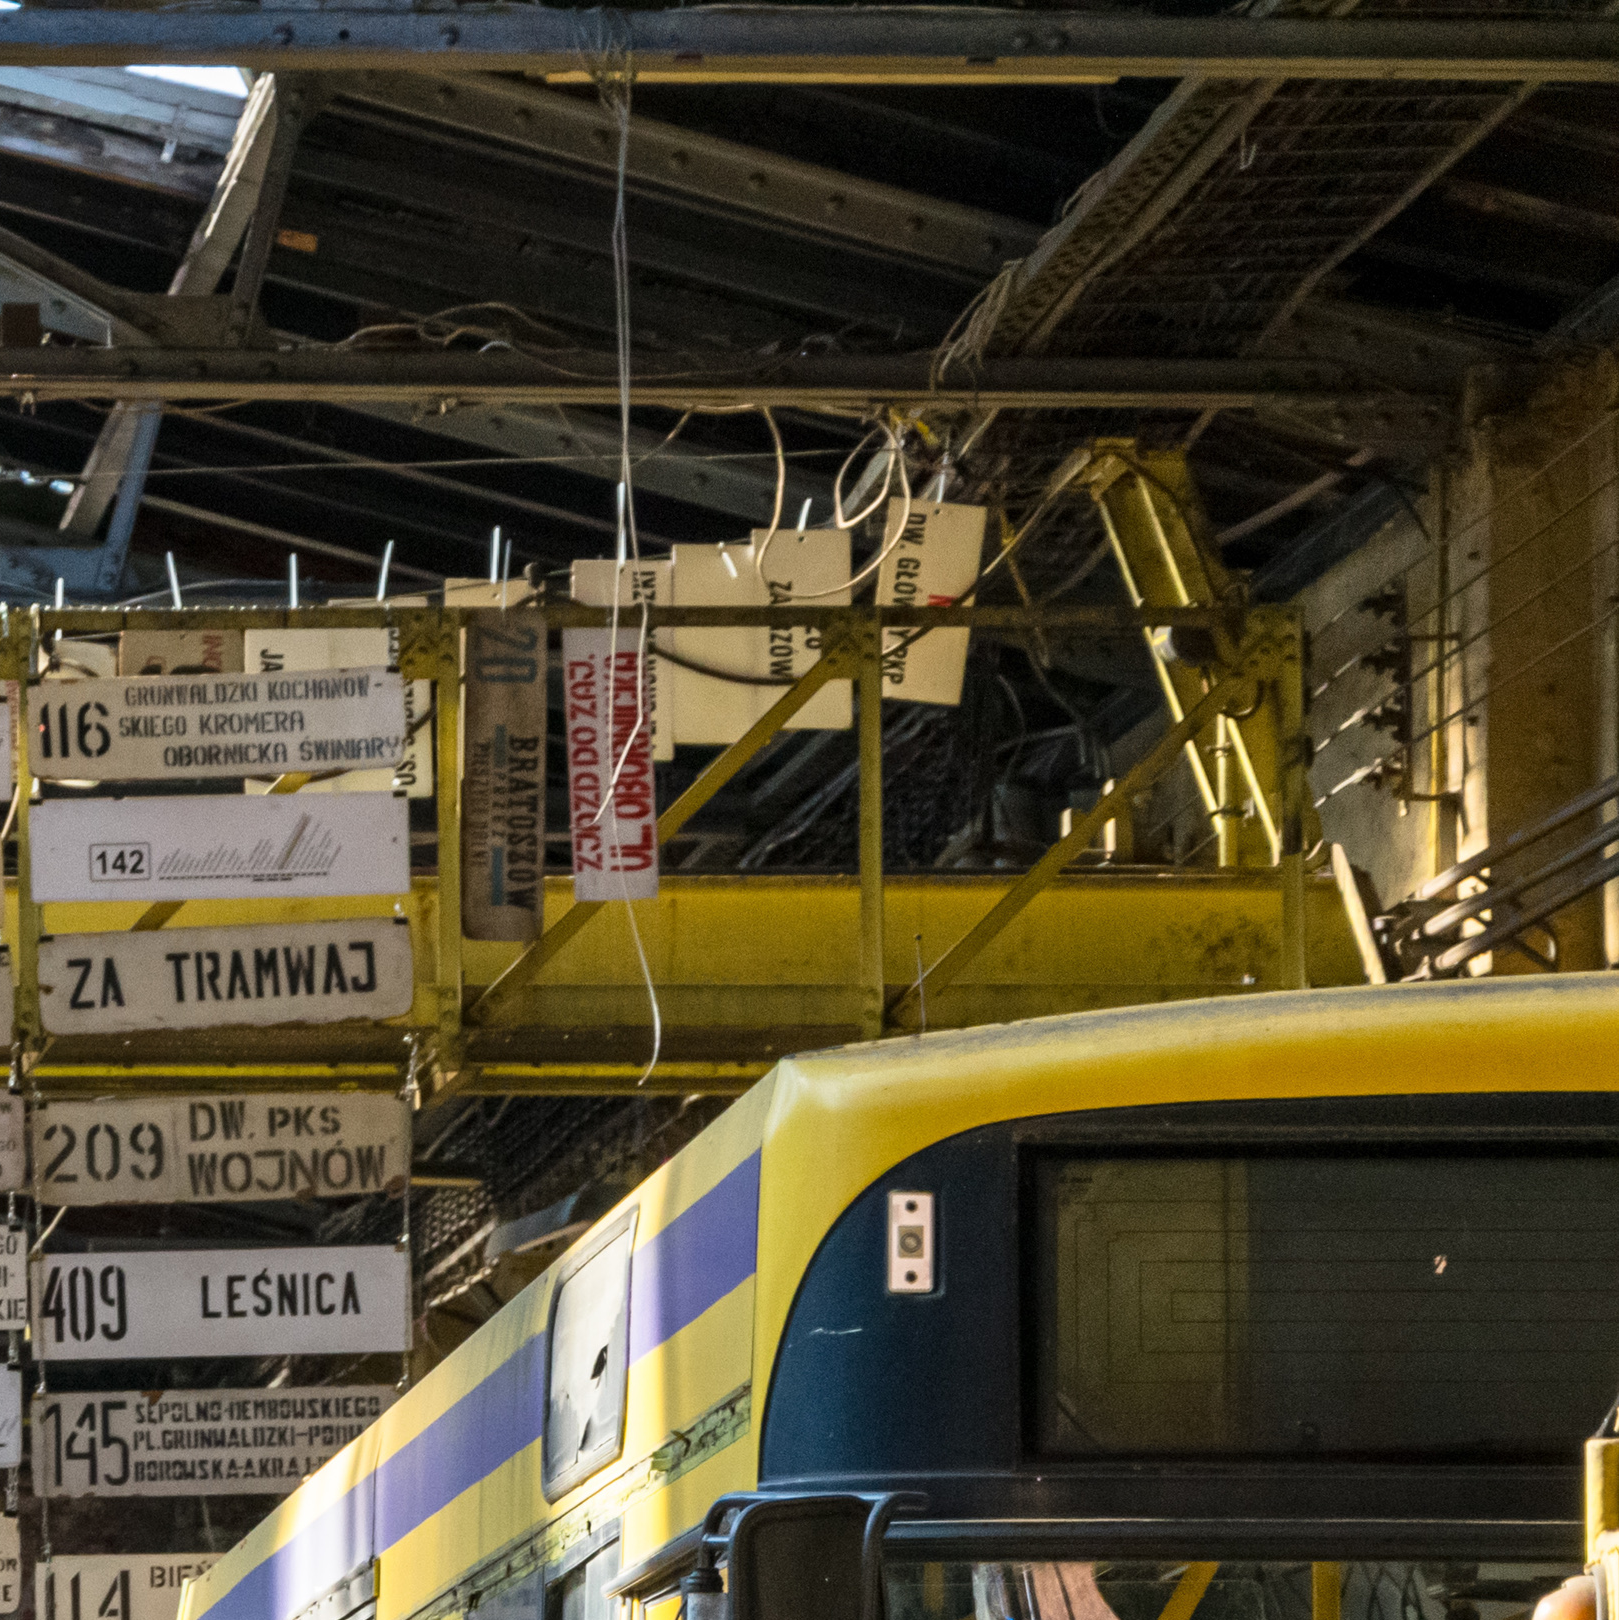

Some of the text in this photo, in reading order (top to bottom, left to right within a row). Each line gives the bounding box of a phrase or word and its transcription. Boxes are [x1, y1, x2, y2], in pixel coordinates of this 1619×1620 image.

[124, 680, 259, 706] GRUNWALDZKI
[39, 702, 305, 758] 116 SKIEGO KROMERA
[163, 741, 288, 767] OBORNICKA
[569, 653, 603, 872] ZJAZD DO ZAJ.
[95, 848, 145, 876] 142
[609, 824, 653, 872] UL.
[67, 941, 378, 1010] ZA TRAMWAJ
[42, 1102, 342, 1183] 209 DW. PKS
[187, 1140, 386, 1198] WOJNÓW
[40, 1265, 362, 1343] 409 LEŚNICA
[41, 1400, 129, 1487] 145
